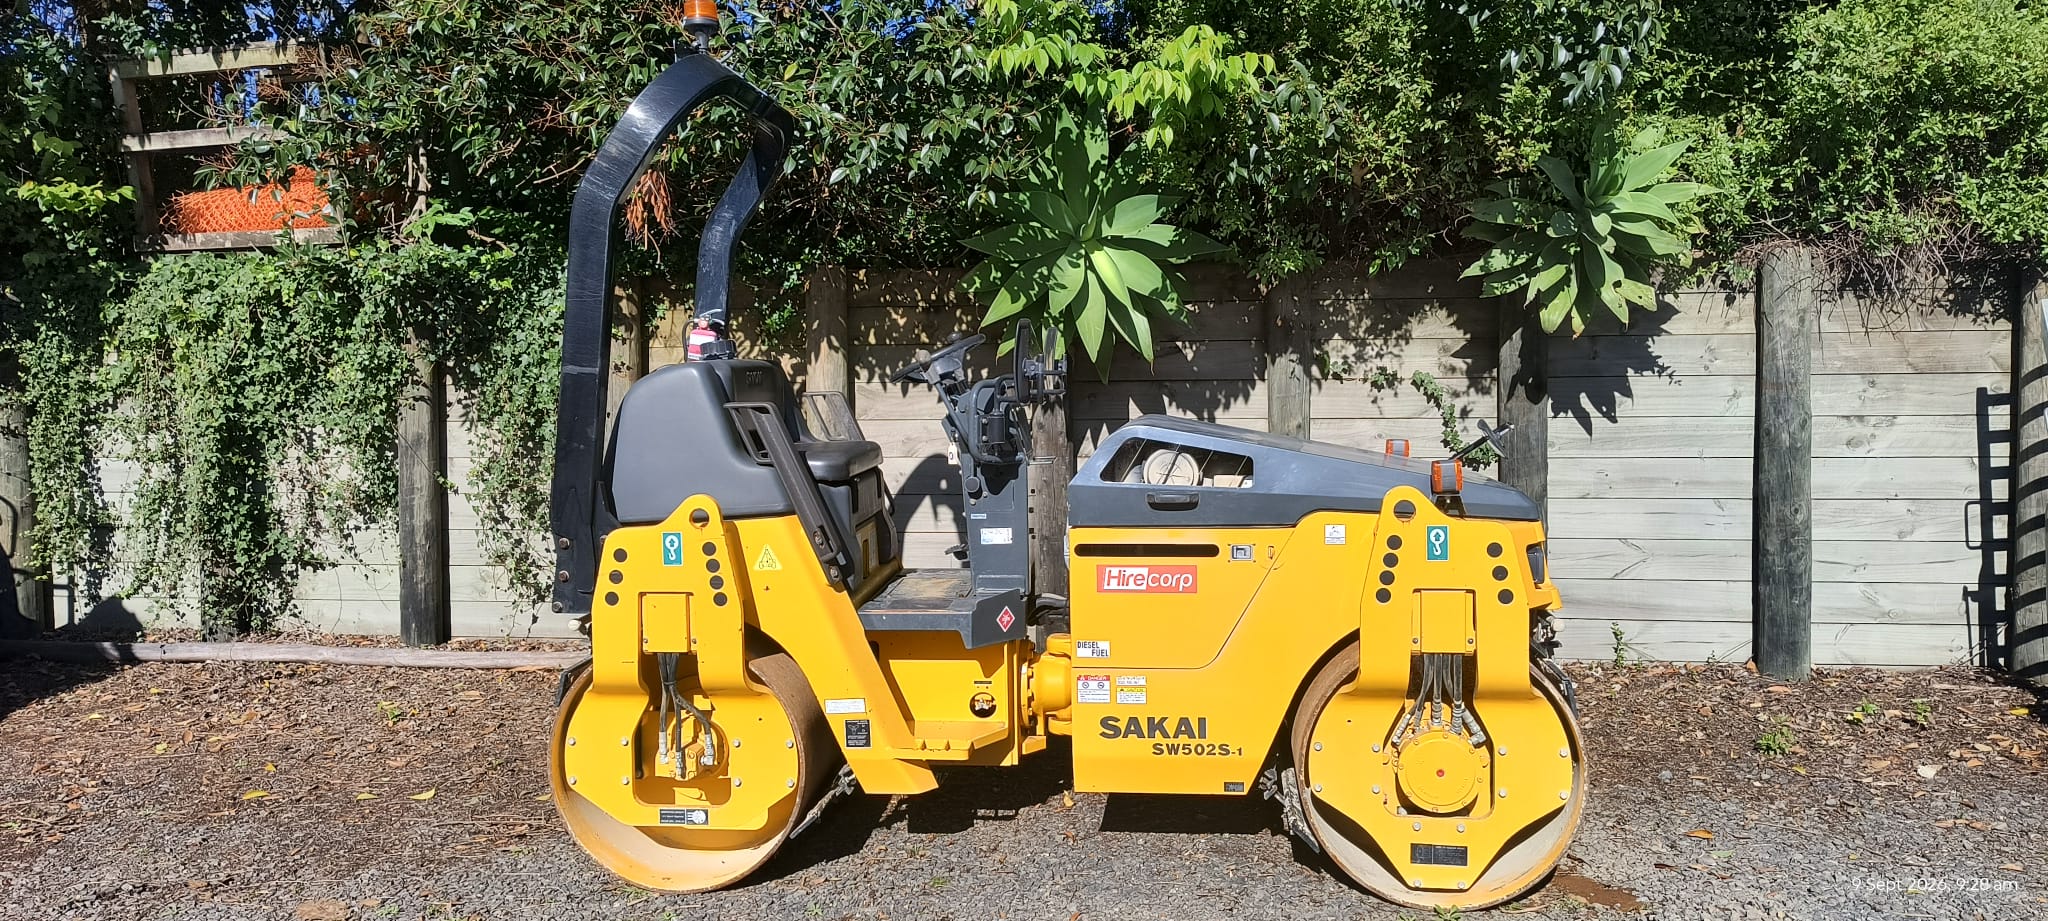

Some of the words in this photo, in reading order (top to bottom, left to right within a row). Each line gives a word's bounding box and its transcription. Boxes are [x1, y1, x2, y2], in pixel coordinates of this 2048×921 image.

[1106, 569, 1193, 592] Hirecorp
[1077, 641, 1100, 649] DIESEL
[1091, 649, 1109, 657] FUEL
[1099, 715, 1207, 739] SAKAI
[1152, 743, 1243, 756] SW502S-1
